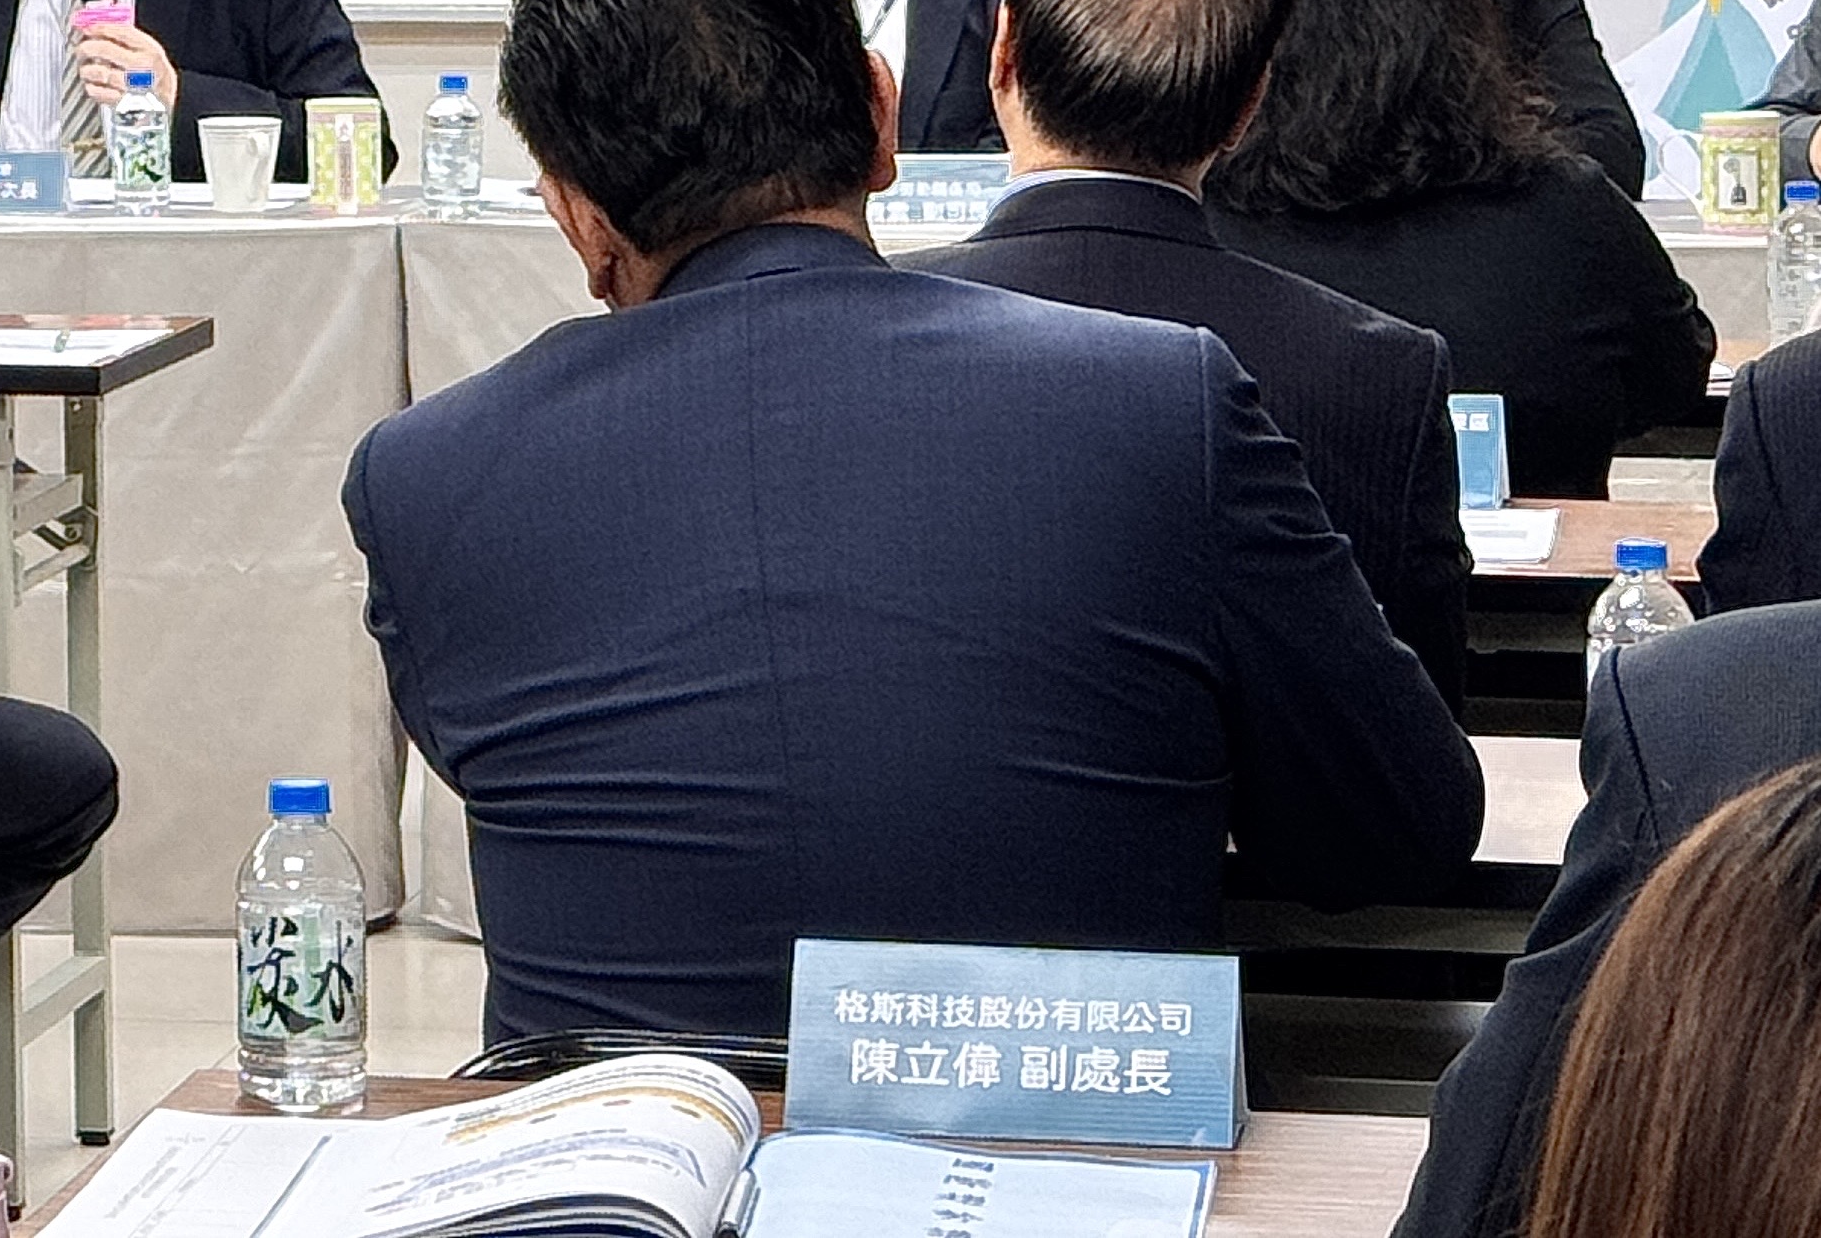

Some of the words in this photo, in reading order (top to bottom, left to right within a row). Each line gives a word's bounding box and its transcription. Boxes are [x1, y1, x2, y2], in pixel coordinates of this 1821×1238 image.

[835, 988, 1193, 1037] 格斯科技股份有限公司
[850, 1037, 1002, 1089] 陳立偉
[1019, 1044, 1172, 1096] 副處長
